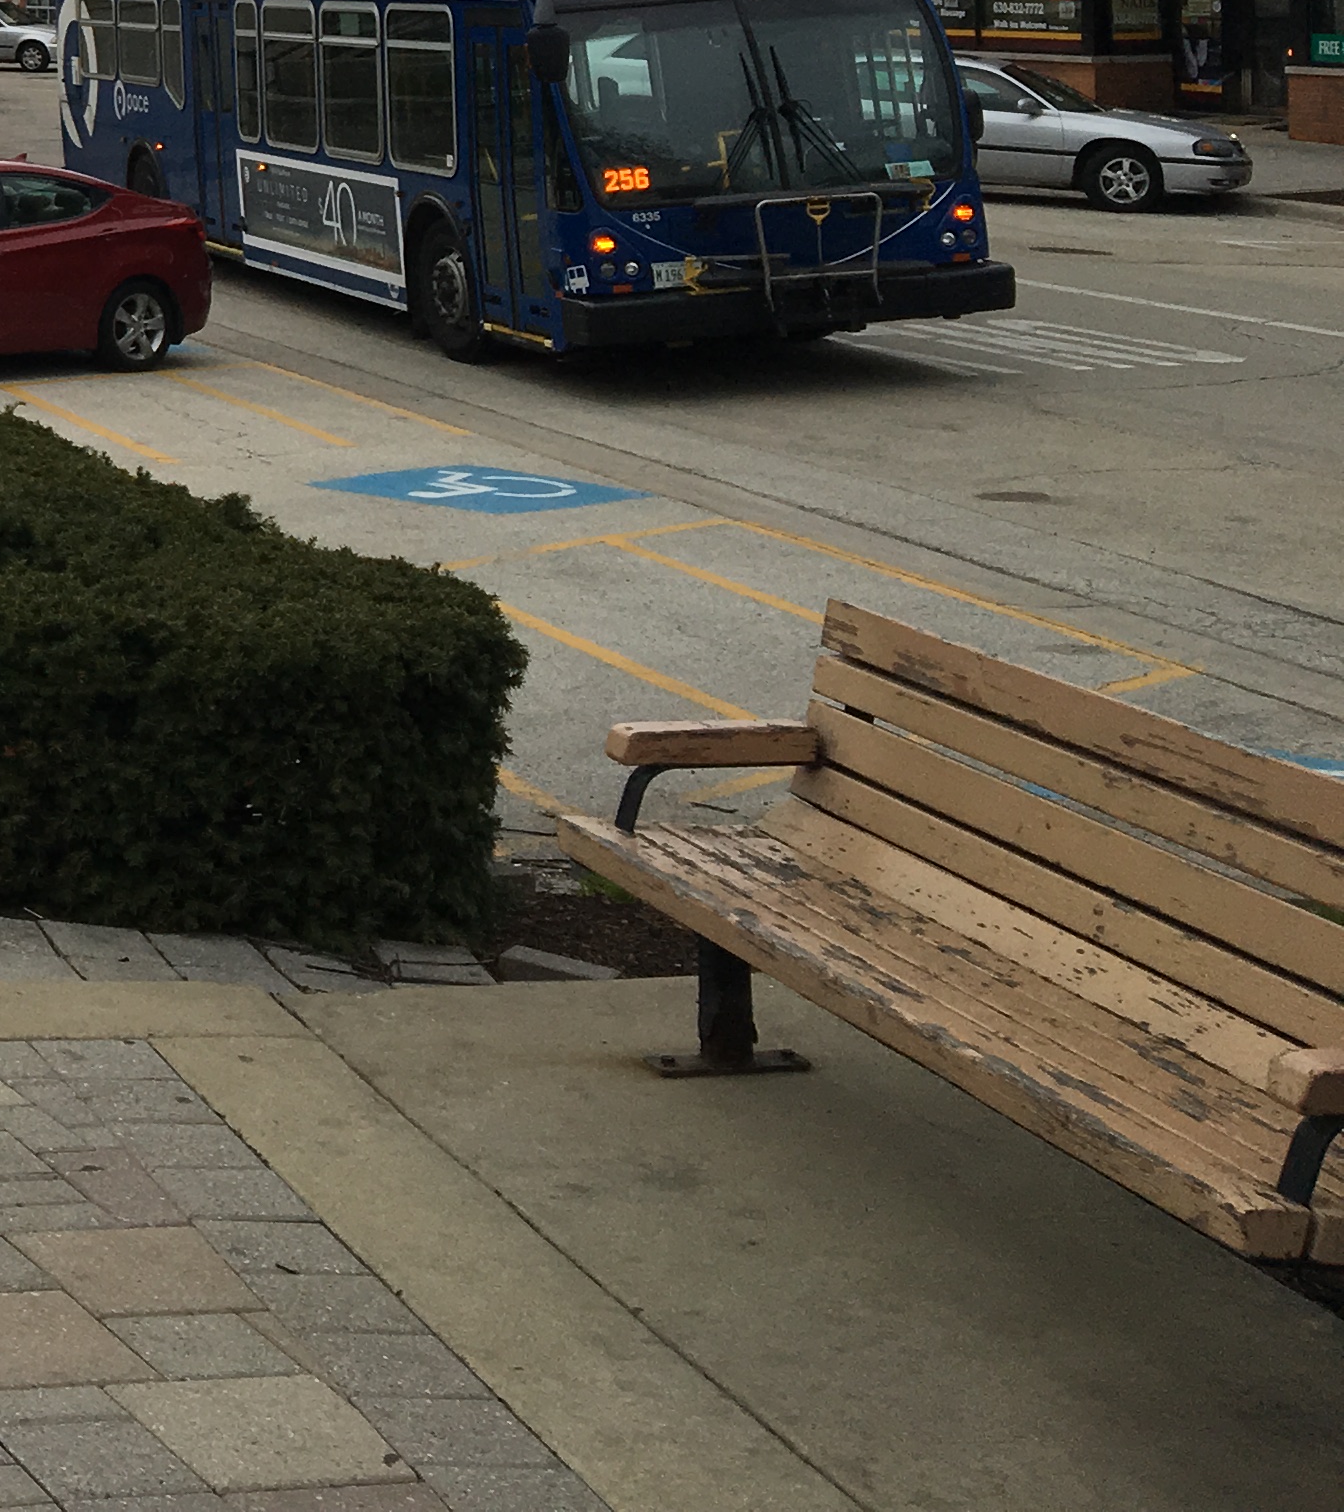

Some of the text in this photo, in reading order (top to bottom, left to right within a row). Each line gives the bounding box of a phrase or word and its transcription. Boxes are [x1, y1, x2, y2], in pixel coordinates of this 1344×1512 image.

[1318, 40, 1341, 56] FREE
[126, 92, 150, 114] pace
[603, 167, 651, 193] 256
[632, 211, 662, 223] 6335
